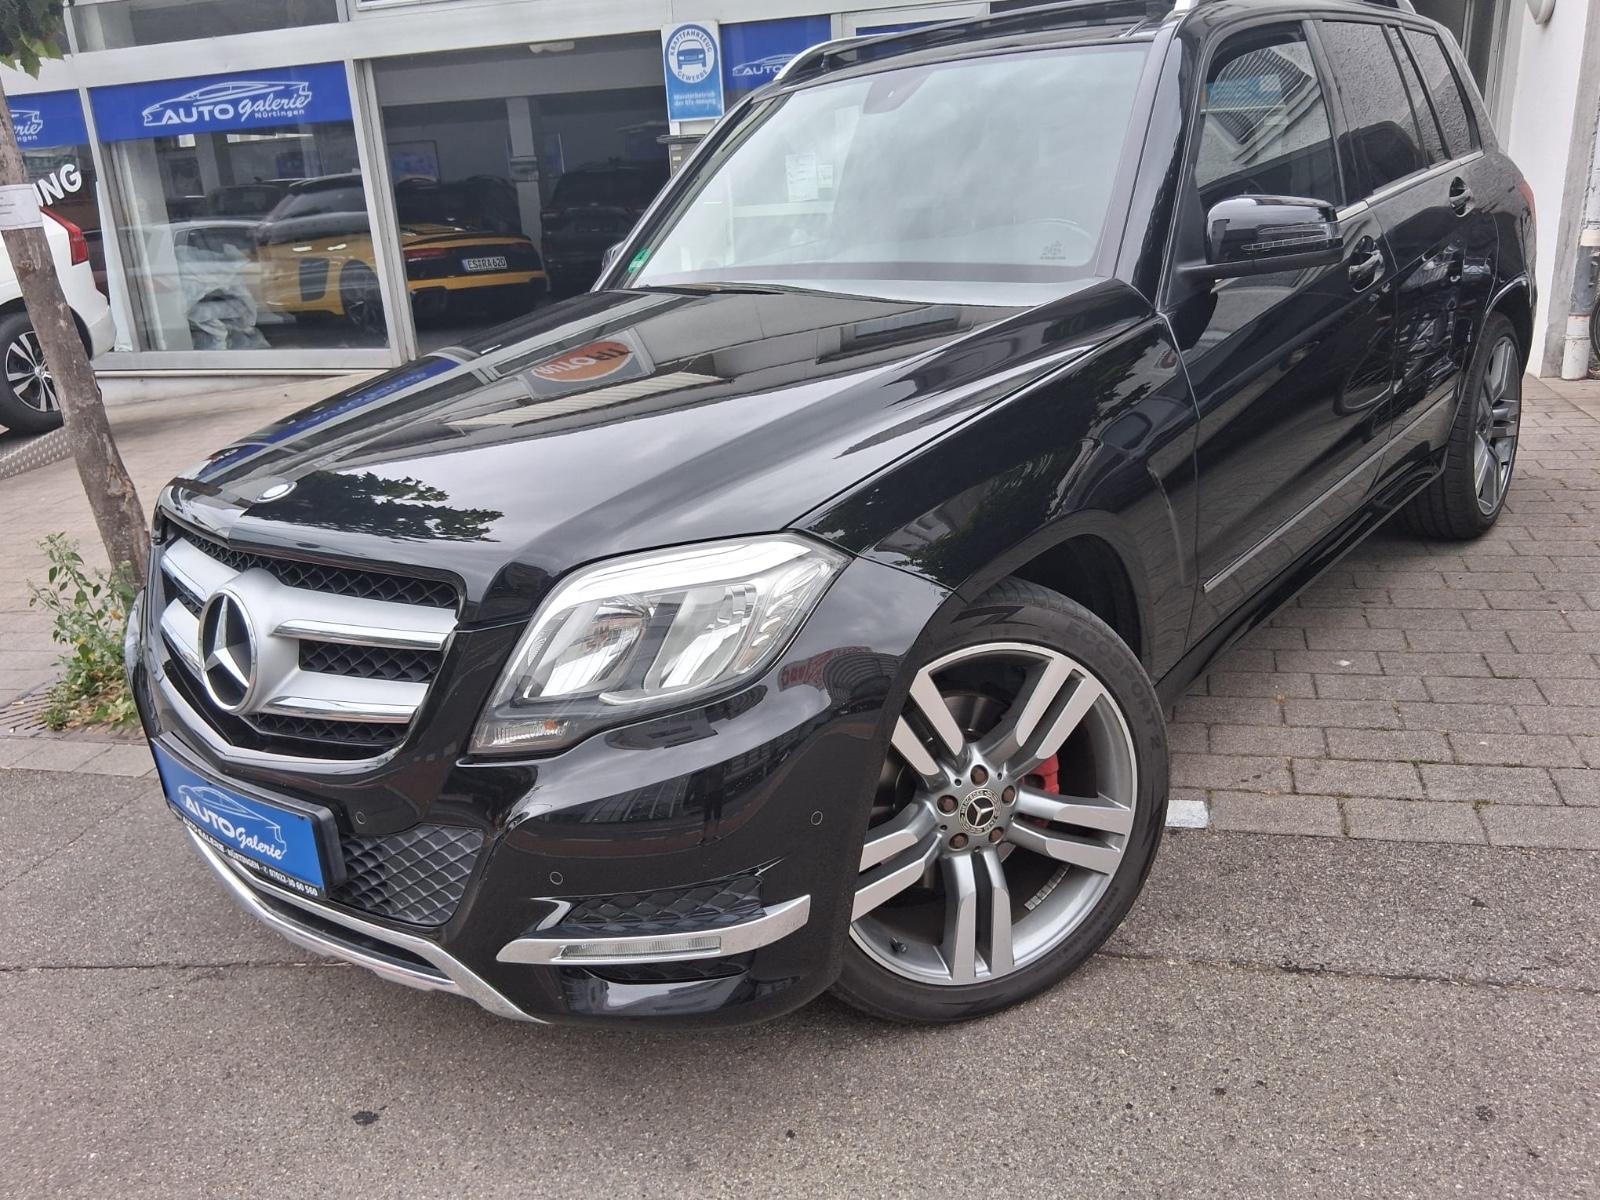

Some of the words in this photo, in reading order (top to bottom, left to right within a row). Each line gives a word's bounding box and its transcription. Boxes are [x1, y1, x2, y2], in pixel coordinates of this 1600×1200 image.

[670, 29, 712, 56] KRAFTFAHRZEUG
[677, 69, 708, 82] GEWERBE
[161, 103, 235, 126] AUTO
[255, 109, 305, 120] Nürtingen
[185, 795, 235, 838] AUTO
